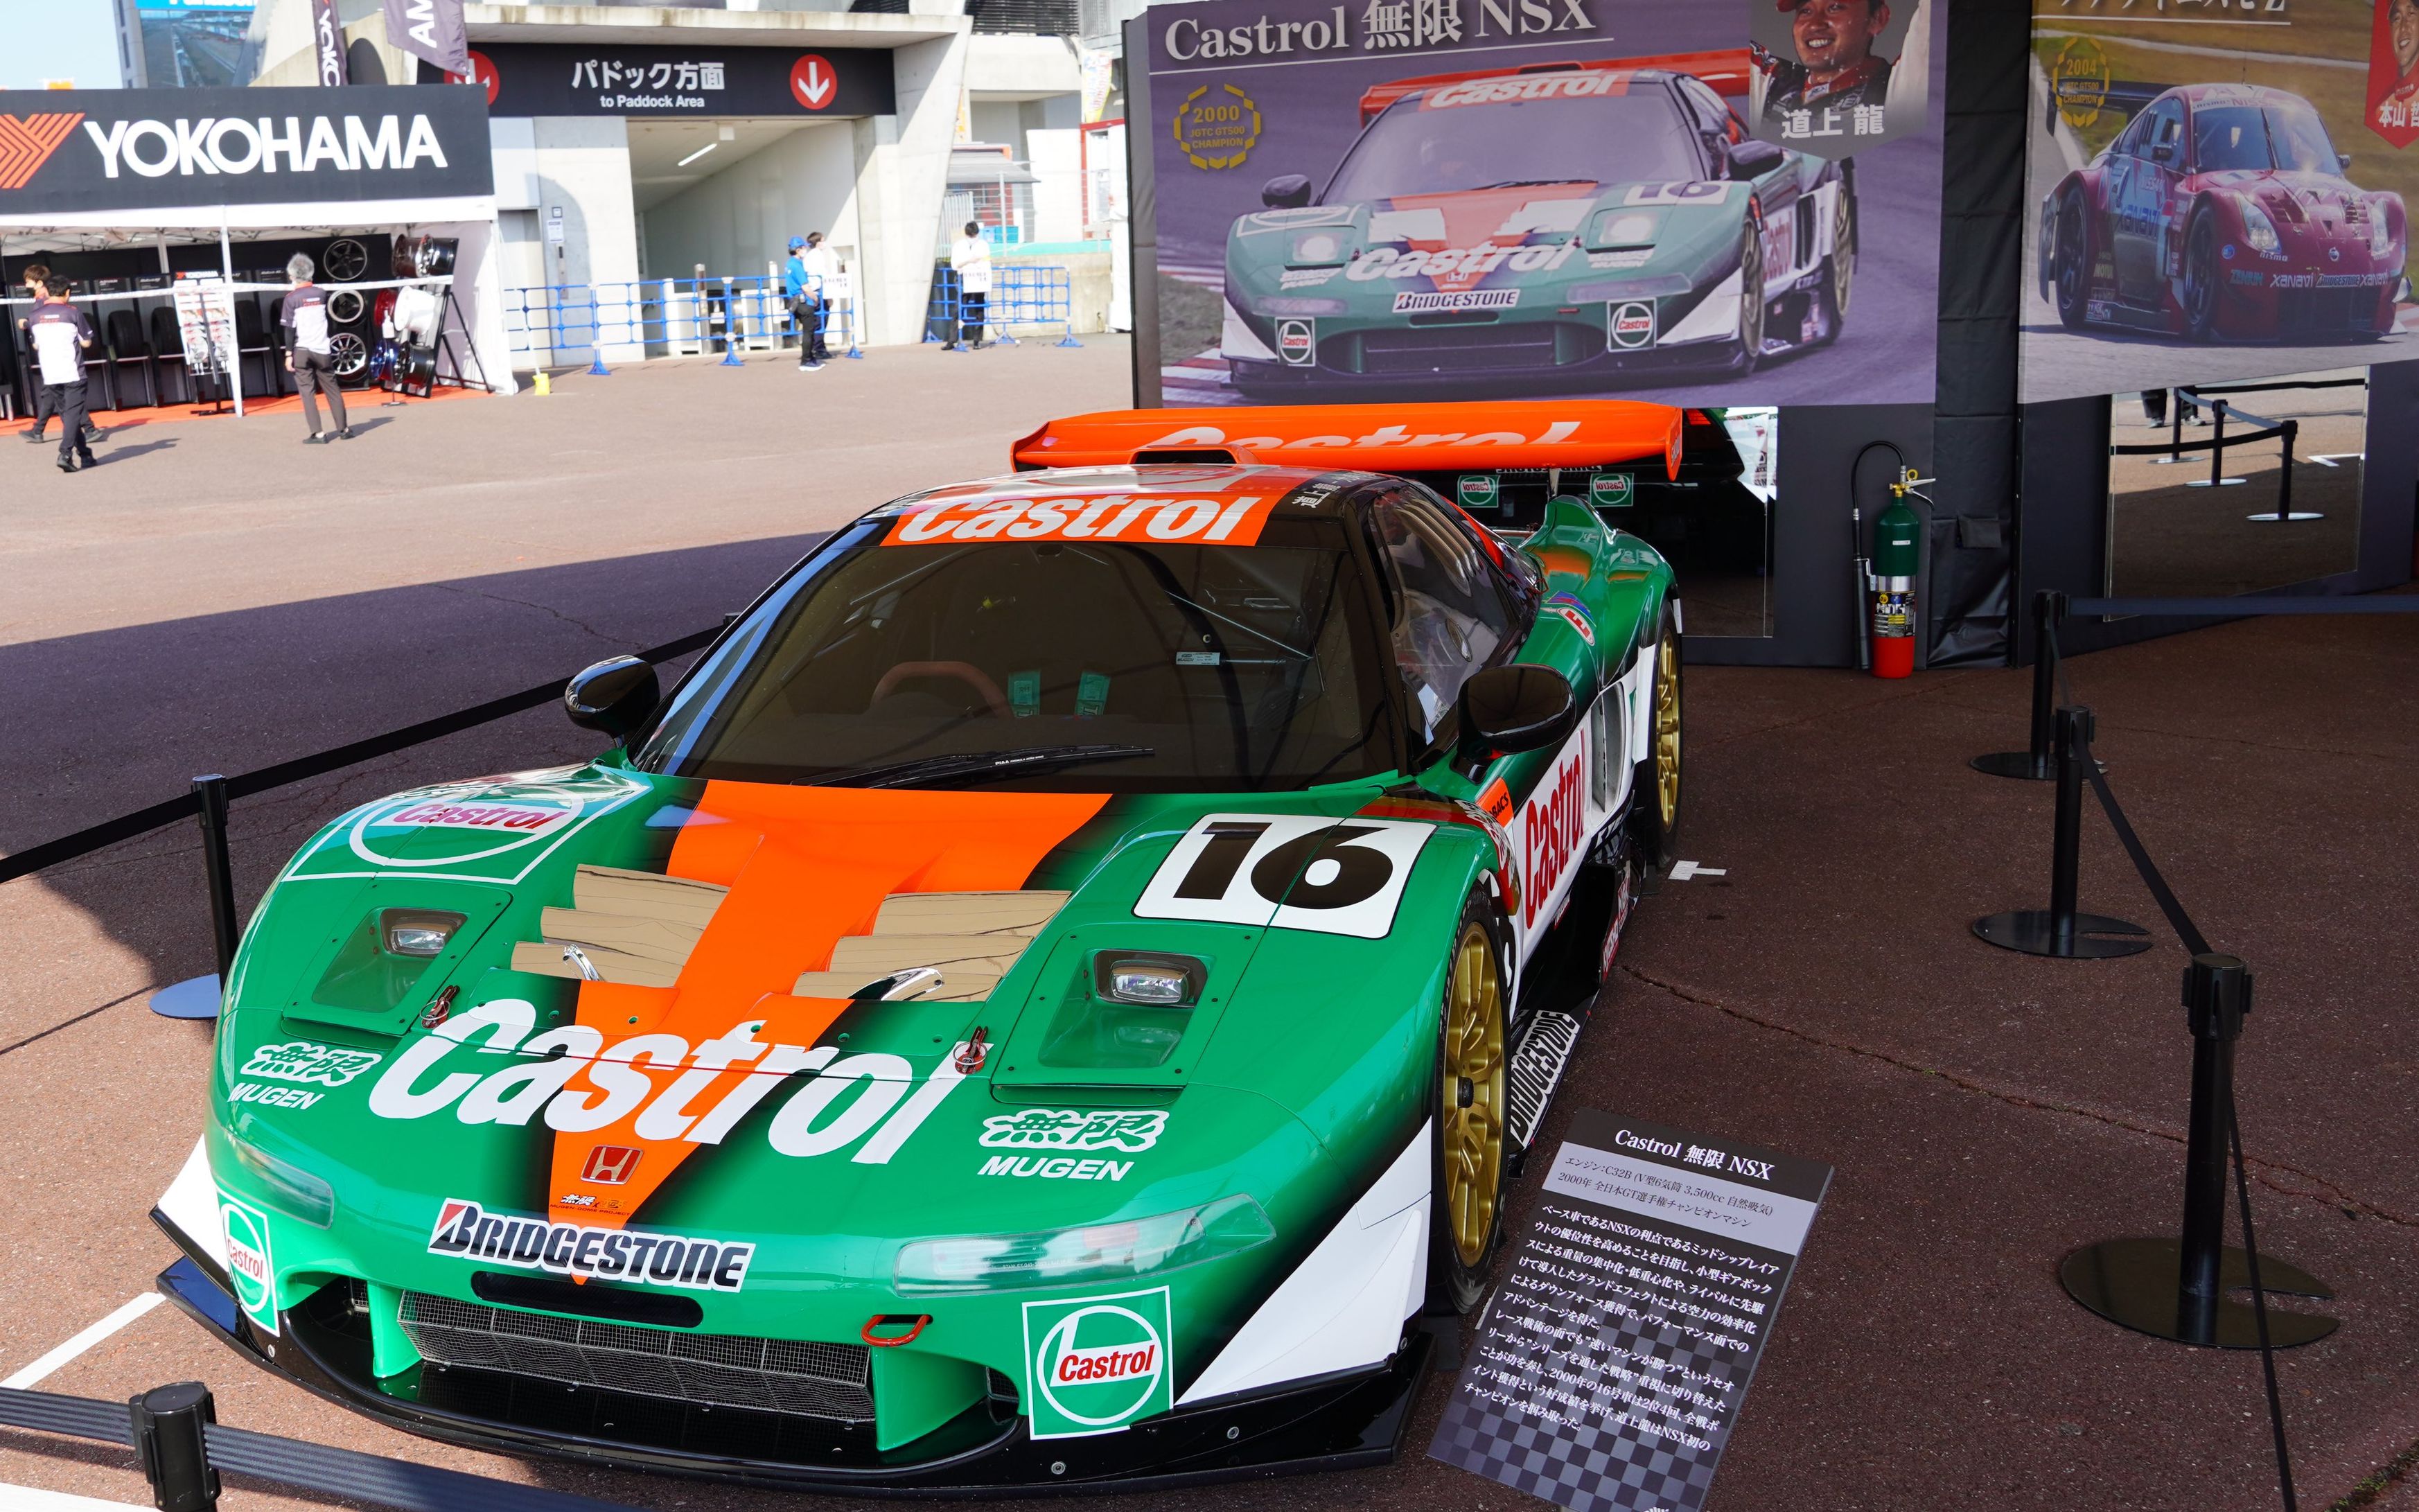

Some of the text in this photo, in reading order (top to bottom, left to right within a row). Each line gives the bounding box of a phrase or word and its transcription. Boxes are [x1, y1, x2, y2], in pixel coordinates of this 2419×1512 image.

[1165, 0, 1596, 60] Castrol 無限 NSX
[571, 59, 725, 90] パドック方面
[2066, 59, 2097, 76] 2004
[600, 95, 705, 107] to Paddock Area
[1429, 71, 1619, 109] Castrol
[2063, 95, 2097, 104] CHAMPION
[1190, 126, 1245, 138] JGTC GT500
[1193, 105, 1240, 123] 2000
[1782, 105, 1884, 139] 道上 龍
[2378, 101, 2406, 128] 本山
[83, 114, 448, 178] YOKOHAMA
[1192, 138, 1243, 149] CHAMPION
[1346, 236, 1578, 281] Castrol
[1396, 290, 1518, 310] BRIDGESTONE
[1283, 336, 1309, 346] Castrol
[1619, 319, 1650, 330] Castrol
[899, 495, 1263, 542] Castrol
[393, 803, 564, 829] Castrol
[1526, 729, 1585, 930] Castrol
[1173, 822, 1393, 910] 16
[240, 1041, 382, 1087] 無限
[369, 998, 994, 1165] Castrol
[1511, 1011, 1577, 1145] BRIDGESTONE
[228, 1082, 326, 1110] MUGEN
[978, 1109, 1170, 1153] 無限
[977, 1156, 1134, 1181] MUGEN
[1615, 1129, 1775, 1181] Castrol 無限 NSX
[1558, 1172, 1751, 1228] 2000年 全日本GT選手権チャンピオンマシン
[1684, 1186, 1725, 1202] 3,500cc
[227, 1238, 263, 1279] Castrol
[435, 1204, 750, 1287] BRIDGESTONE
[1535, 1221, 1772, 1294] ウトの優位性を高めることを目指し、小型ギアボック
[1542, 1205, 1780, 1275] ベース車であるNSXの利点であるミッドシップレイア
[1503, 1291, 1601, 1330] アドバンテージを得た。
[1058, 1345, 1155, 1382] Castrol
